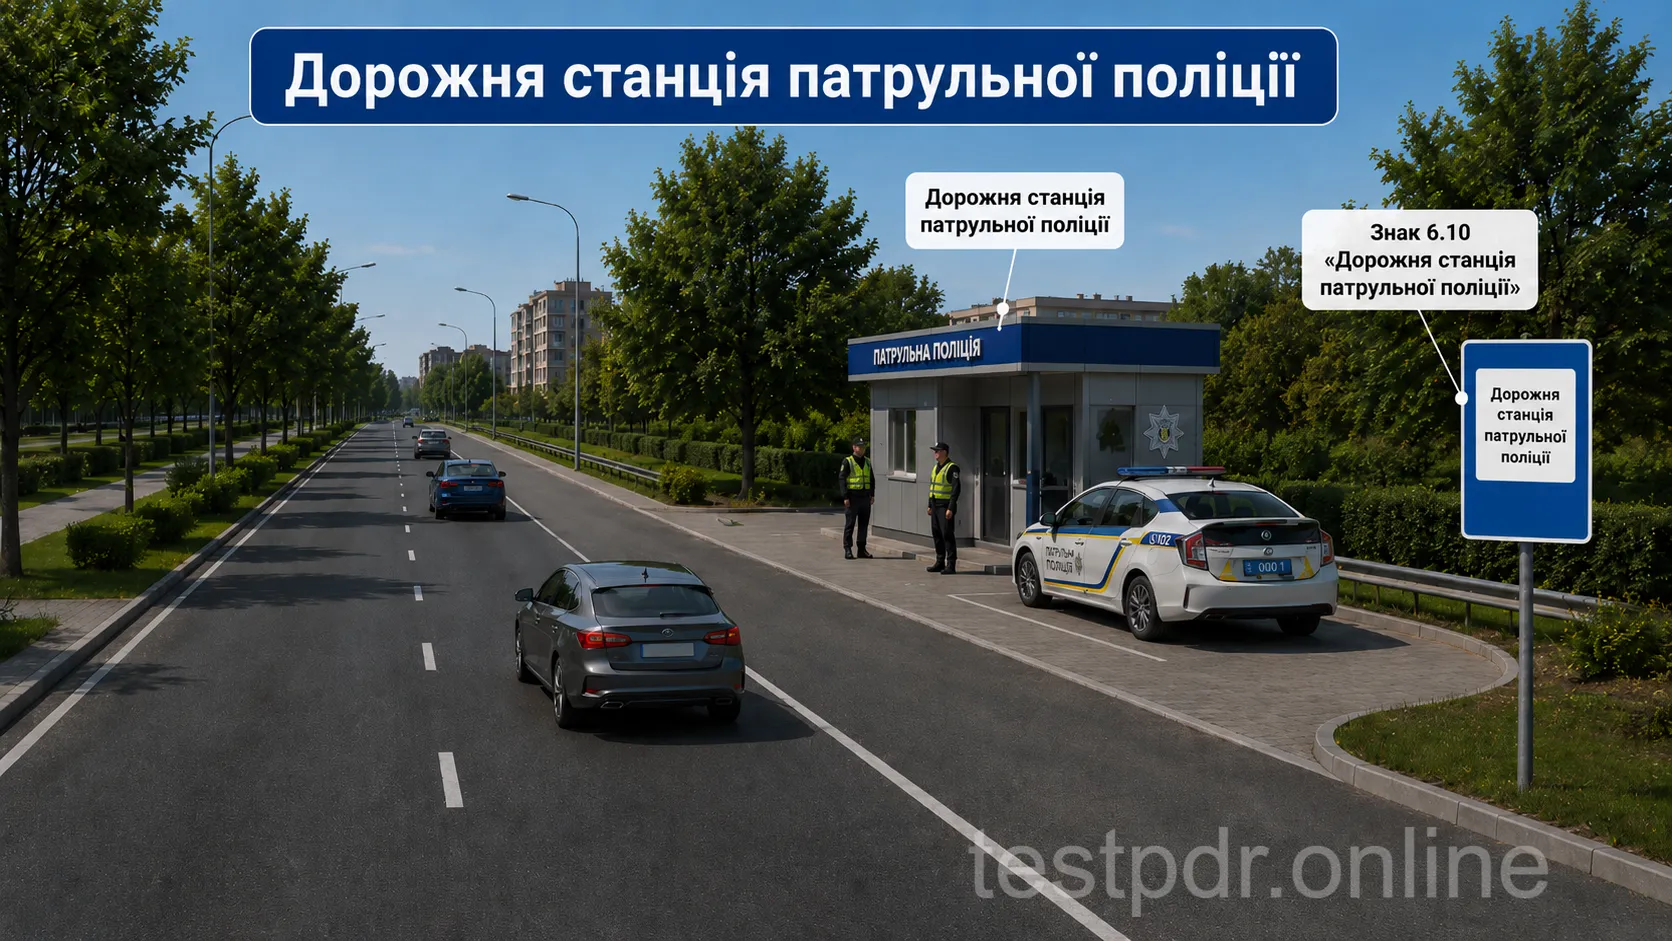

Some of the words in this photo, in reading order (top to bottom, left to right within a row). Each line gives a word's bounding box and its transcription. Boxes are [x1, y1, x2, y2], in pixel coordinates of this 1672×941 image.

[873, 344, 931, 366] ПАТРУЛЬНА
[1490, 387, 1560, 404] Дорожня
[1497, 407, 1554, 424] станція
[1484, 429, 1567, 446] патрульної
[1501, 450, 1552, 466] поліції
